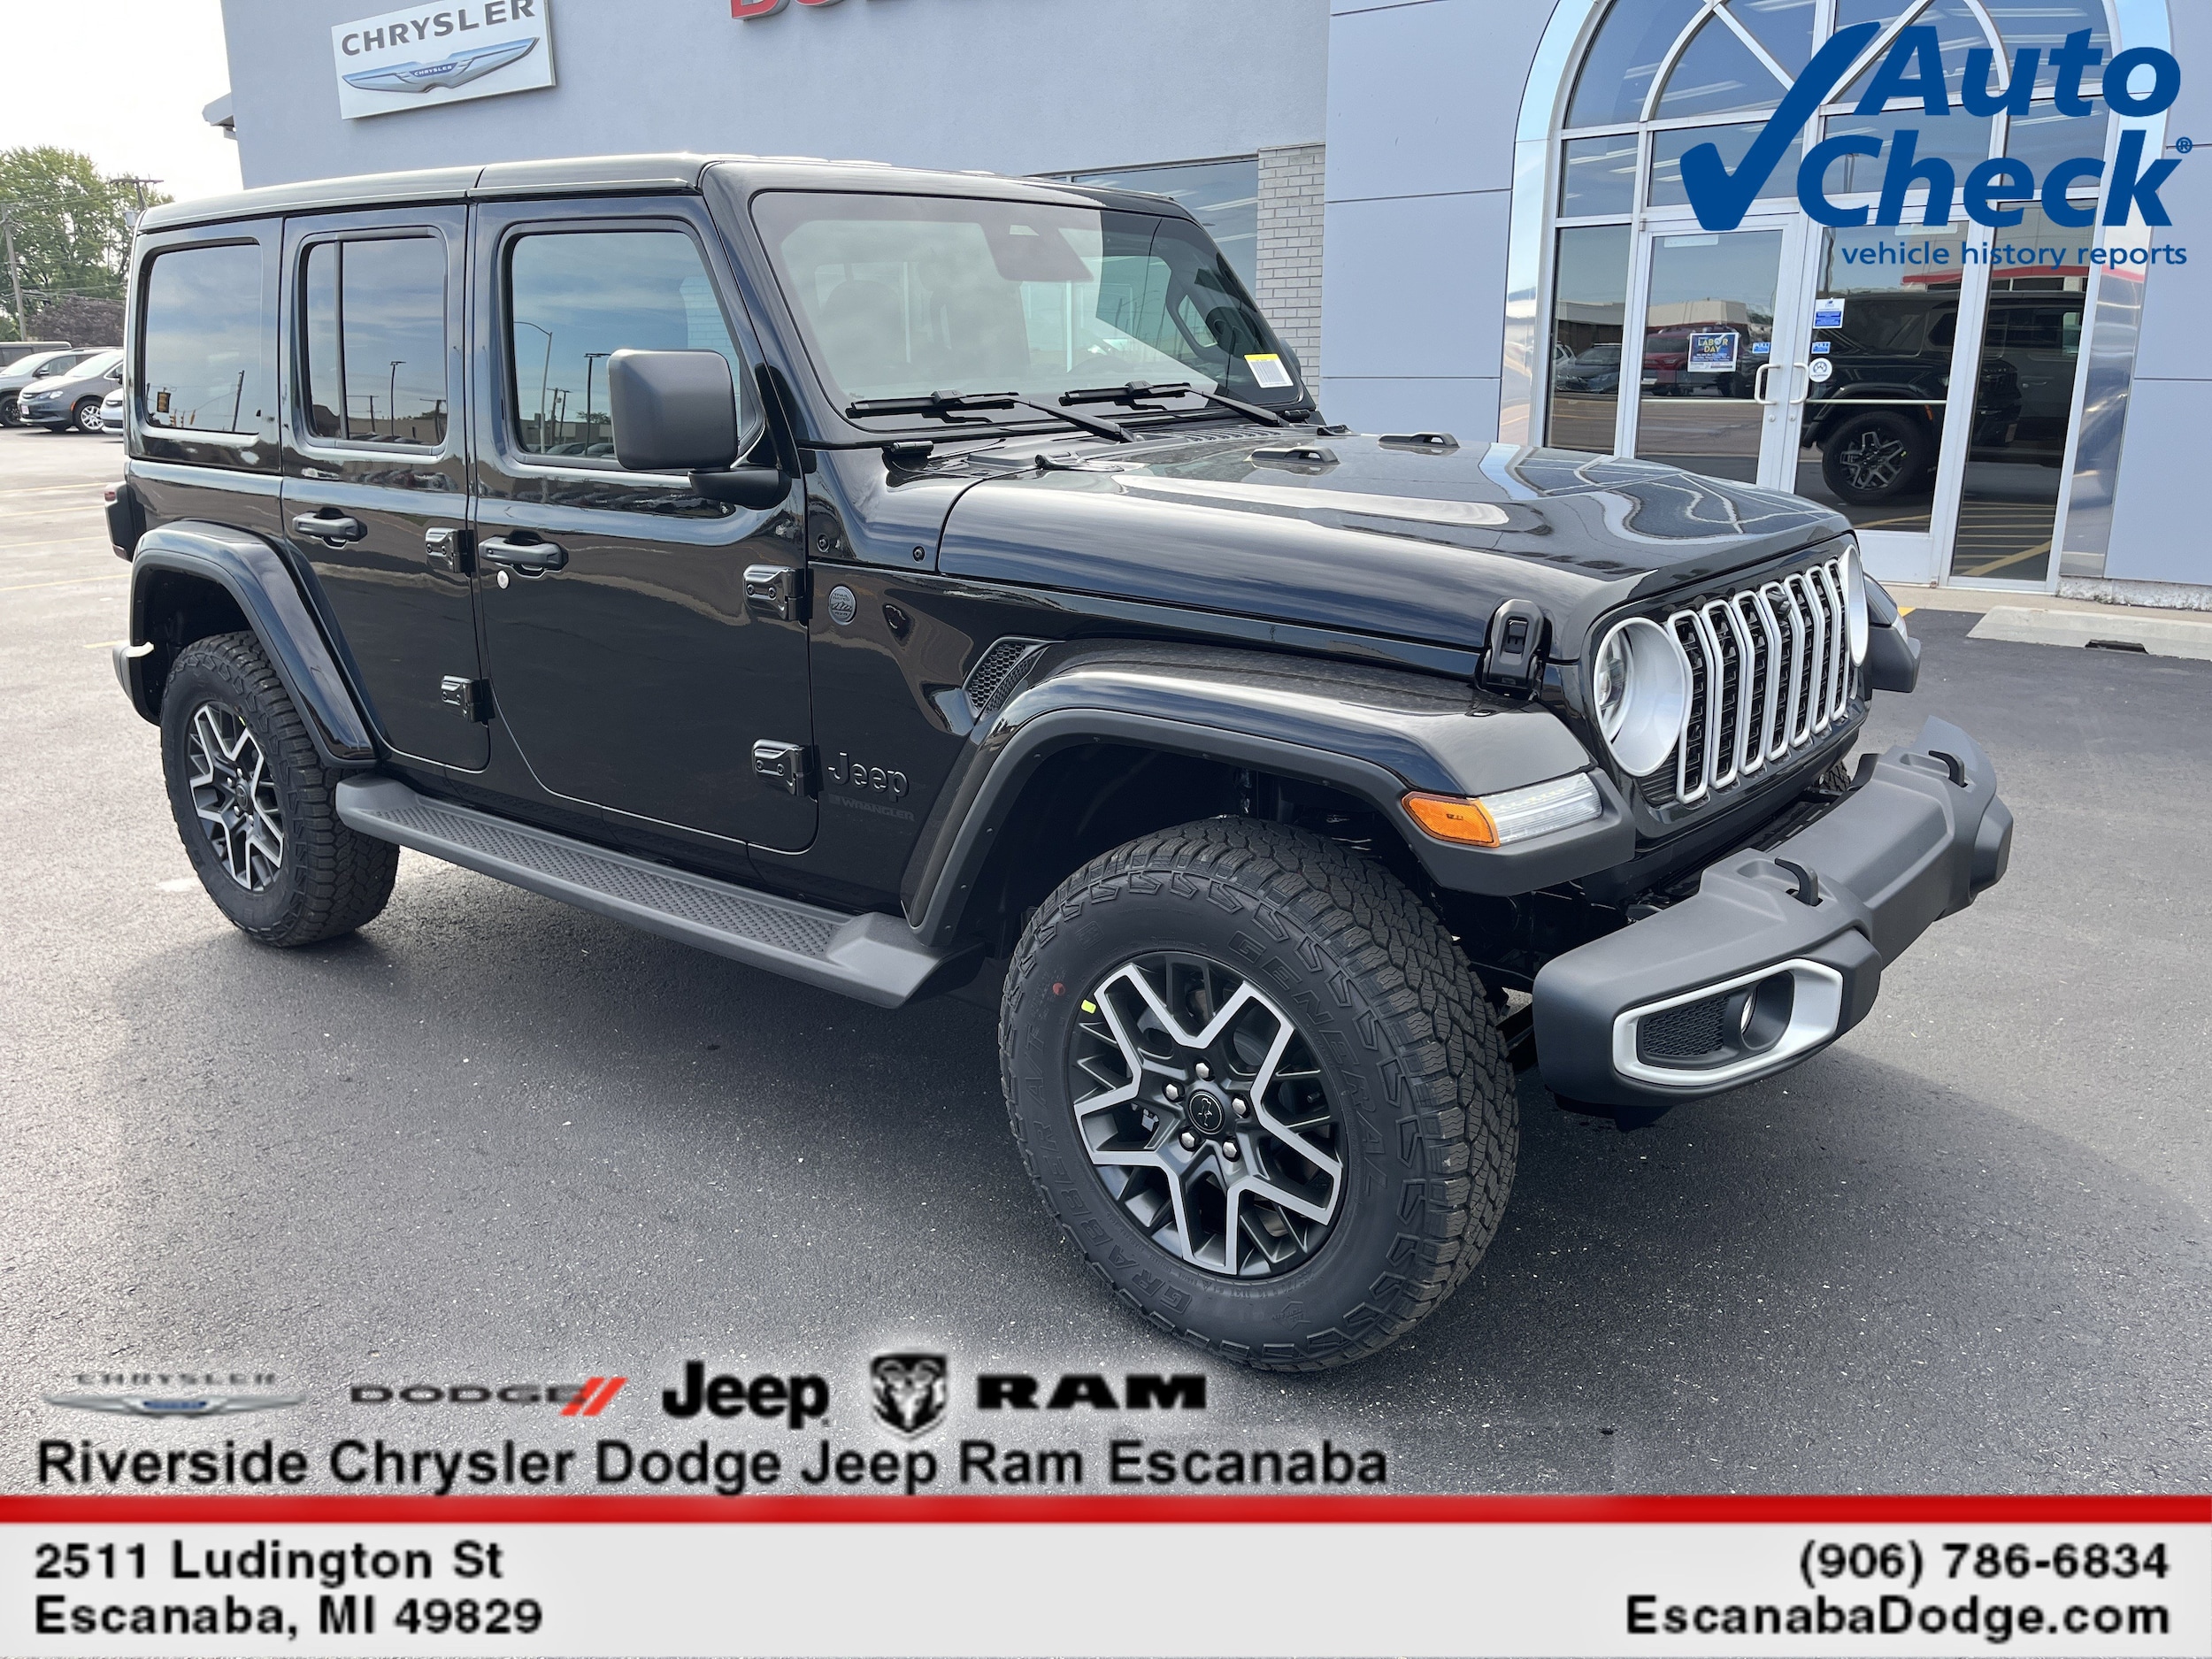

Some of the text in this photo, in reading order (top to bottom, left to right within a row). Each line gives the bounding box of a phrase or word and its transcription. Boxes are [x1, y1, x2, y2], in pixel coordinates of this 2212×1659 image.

[342, 0, 535, 57] CHRYSLER
[413, 64, 453, 77] CHRYSLER
[826, 751, 910, 803] Jeep
[841, 795, 916, 821] WRANGLER
[1226, 930, 1387, 1196] GENERAL
